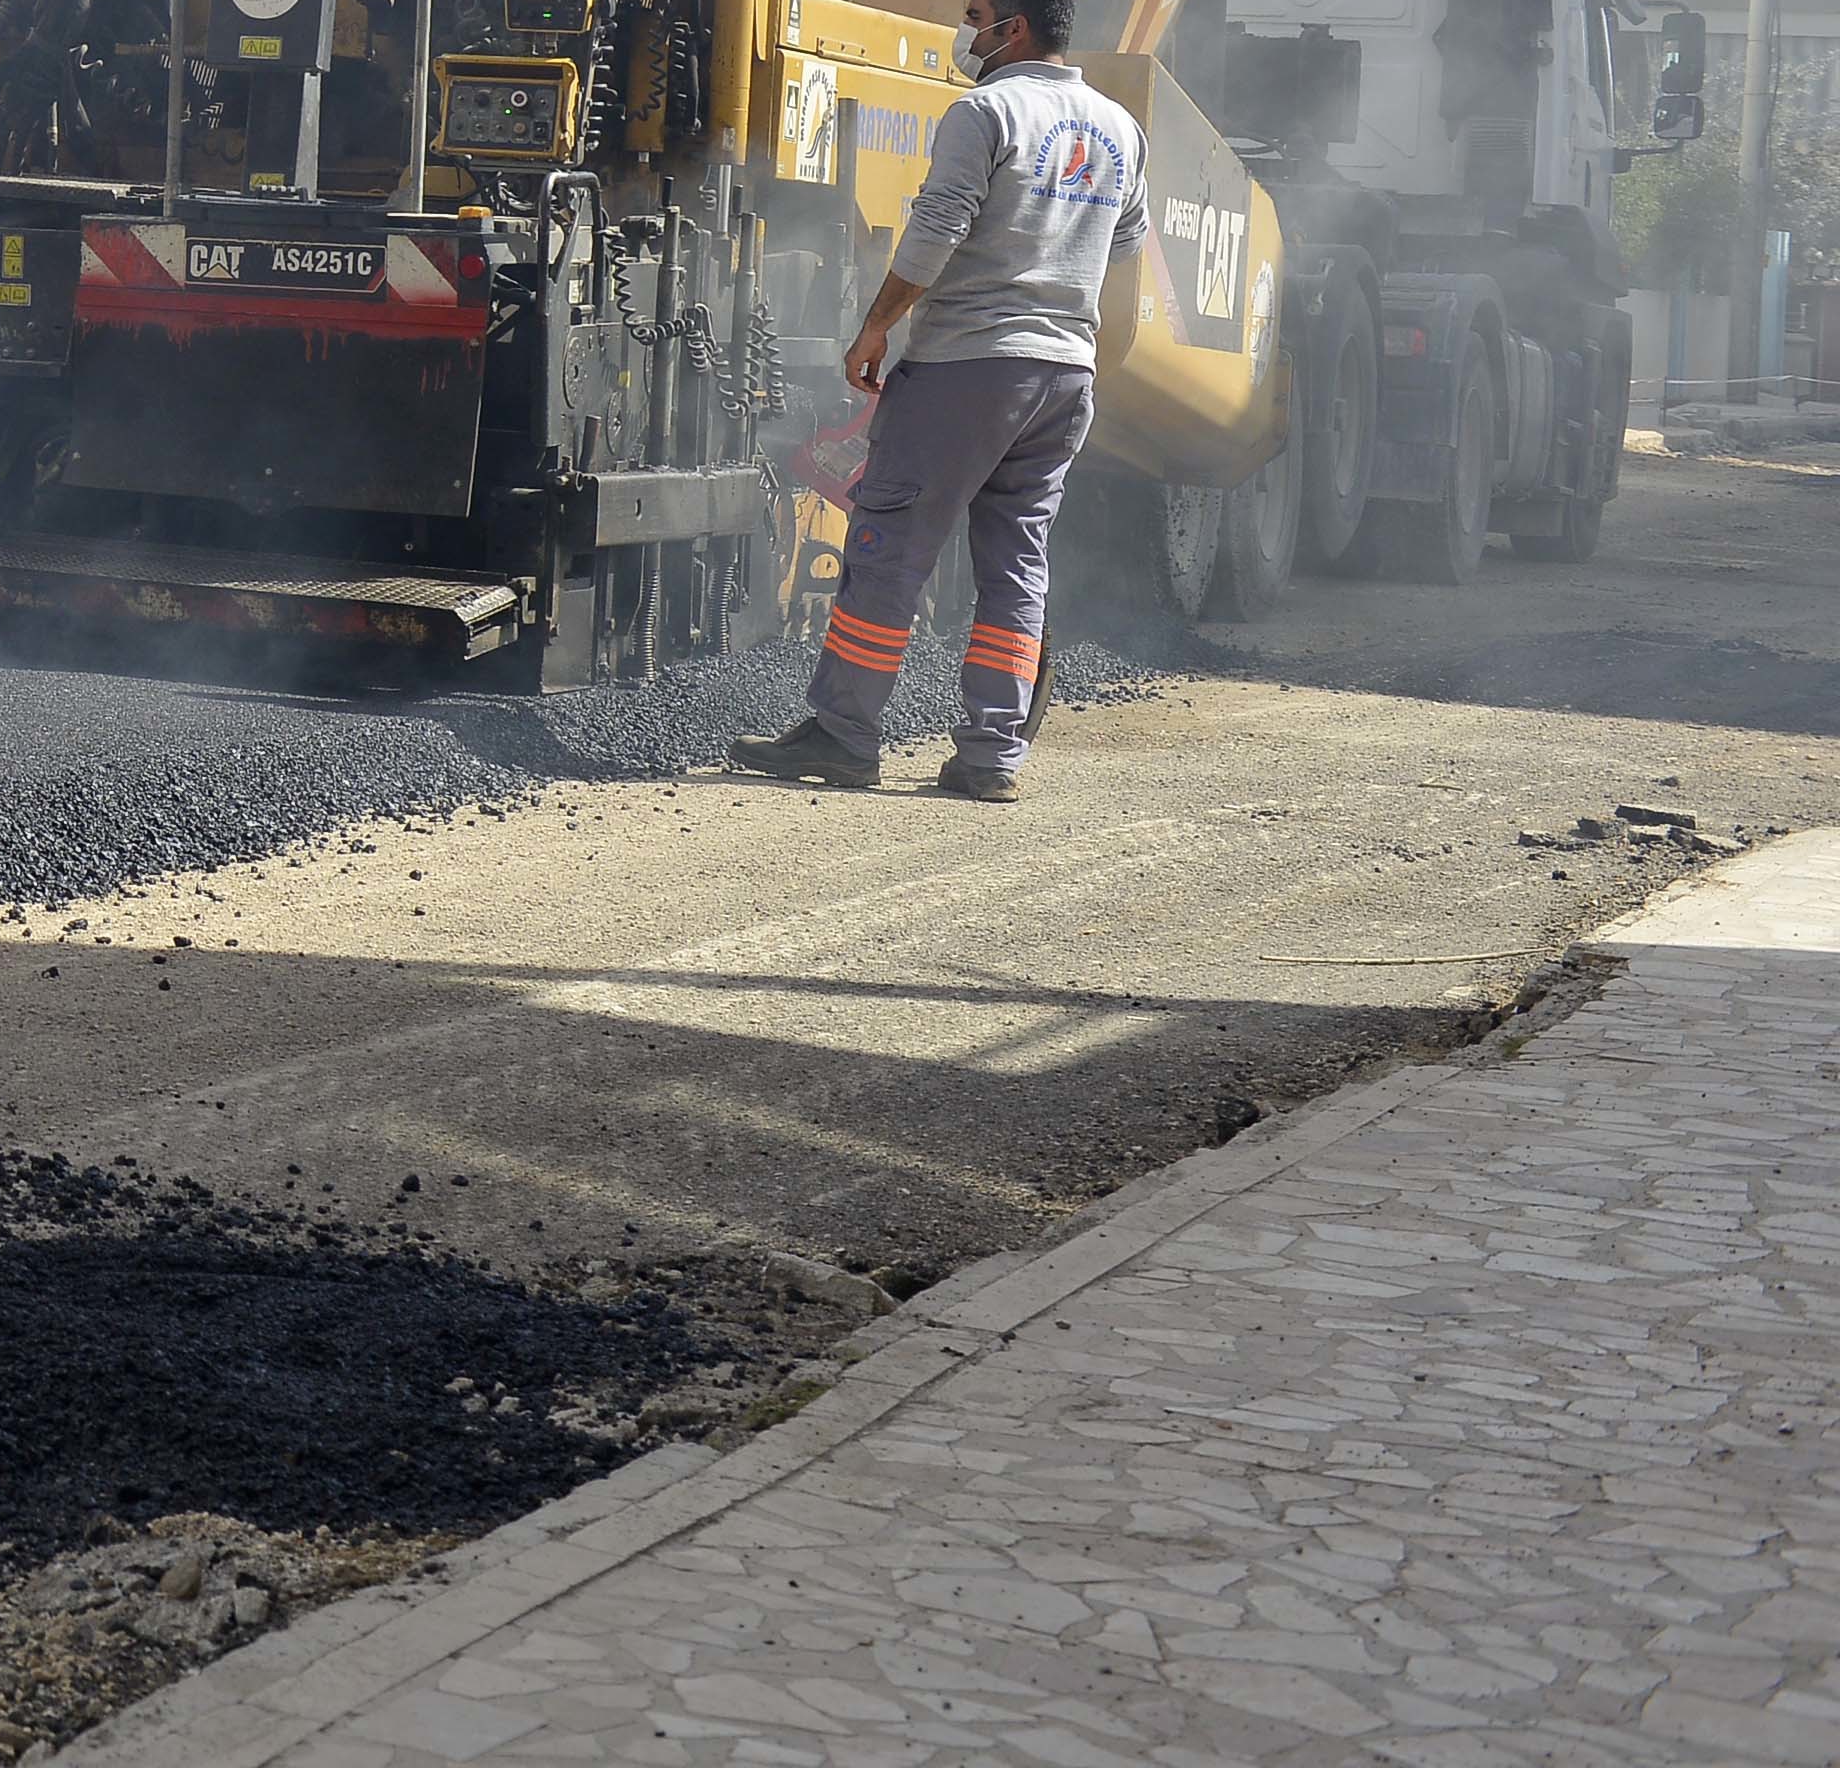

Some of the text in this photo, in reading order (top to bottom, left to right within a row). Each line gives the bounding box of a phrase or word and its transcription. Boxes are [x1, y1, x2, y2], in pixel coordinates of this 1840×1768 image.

[189, 244, 373, 280] CAT AS4251C
[1163, 196, 1246, 321] AP655D CAT
